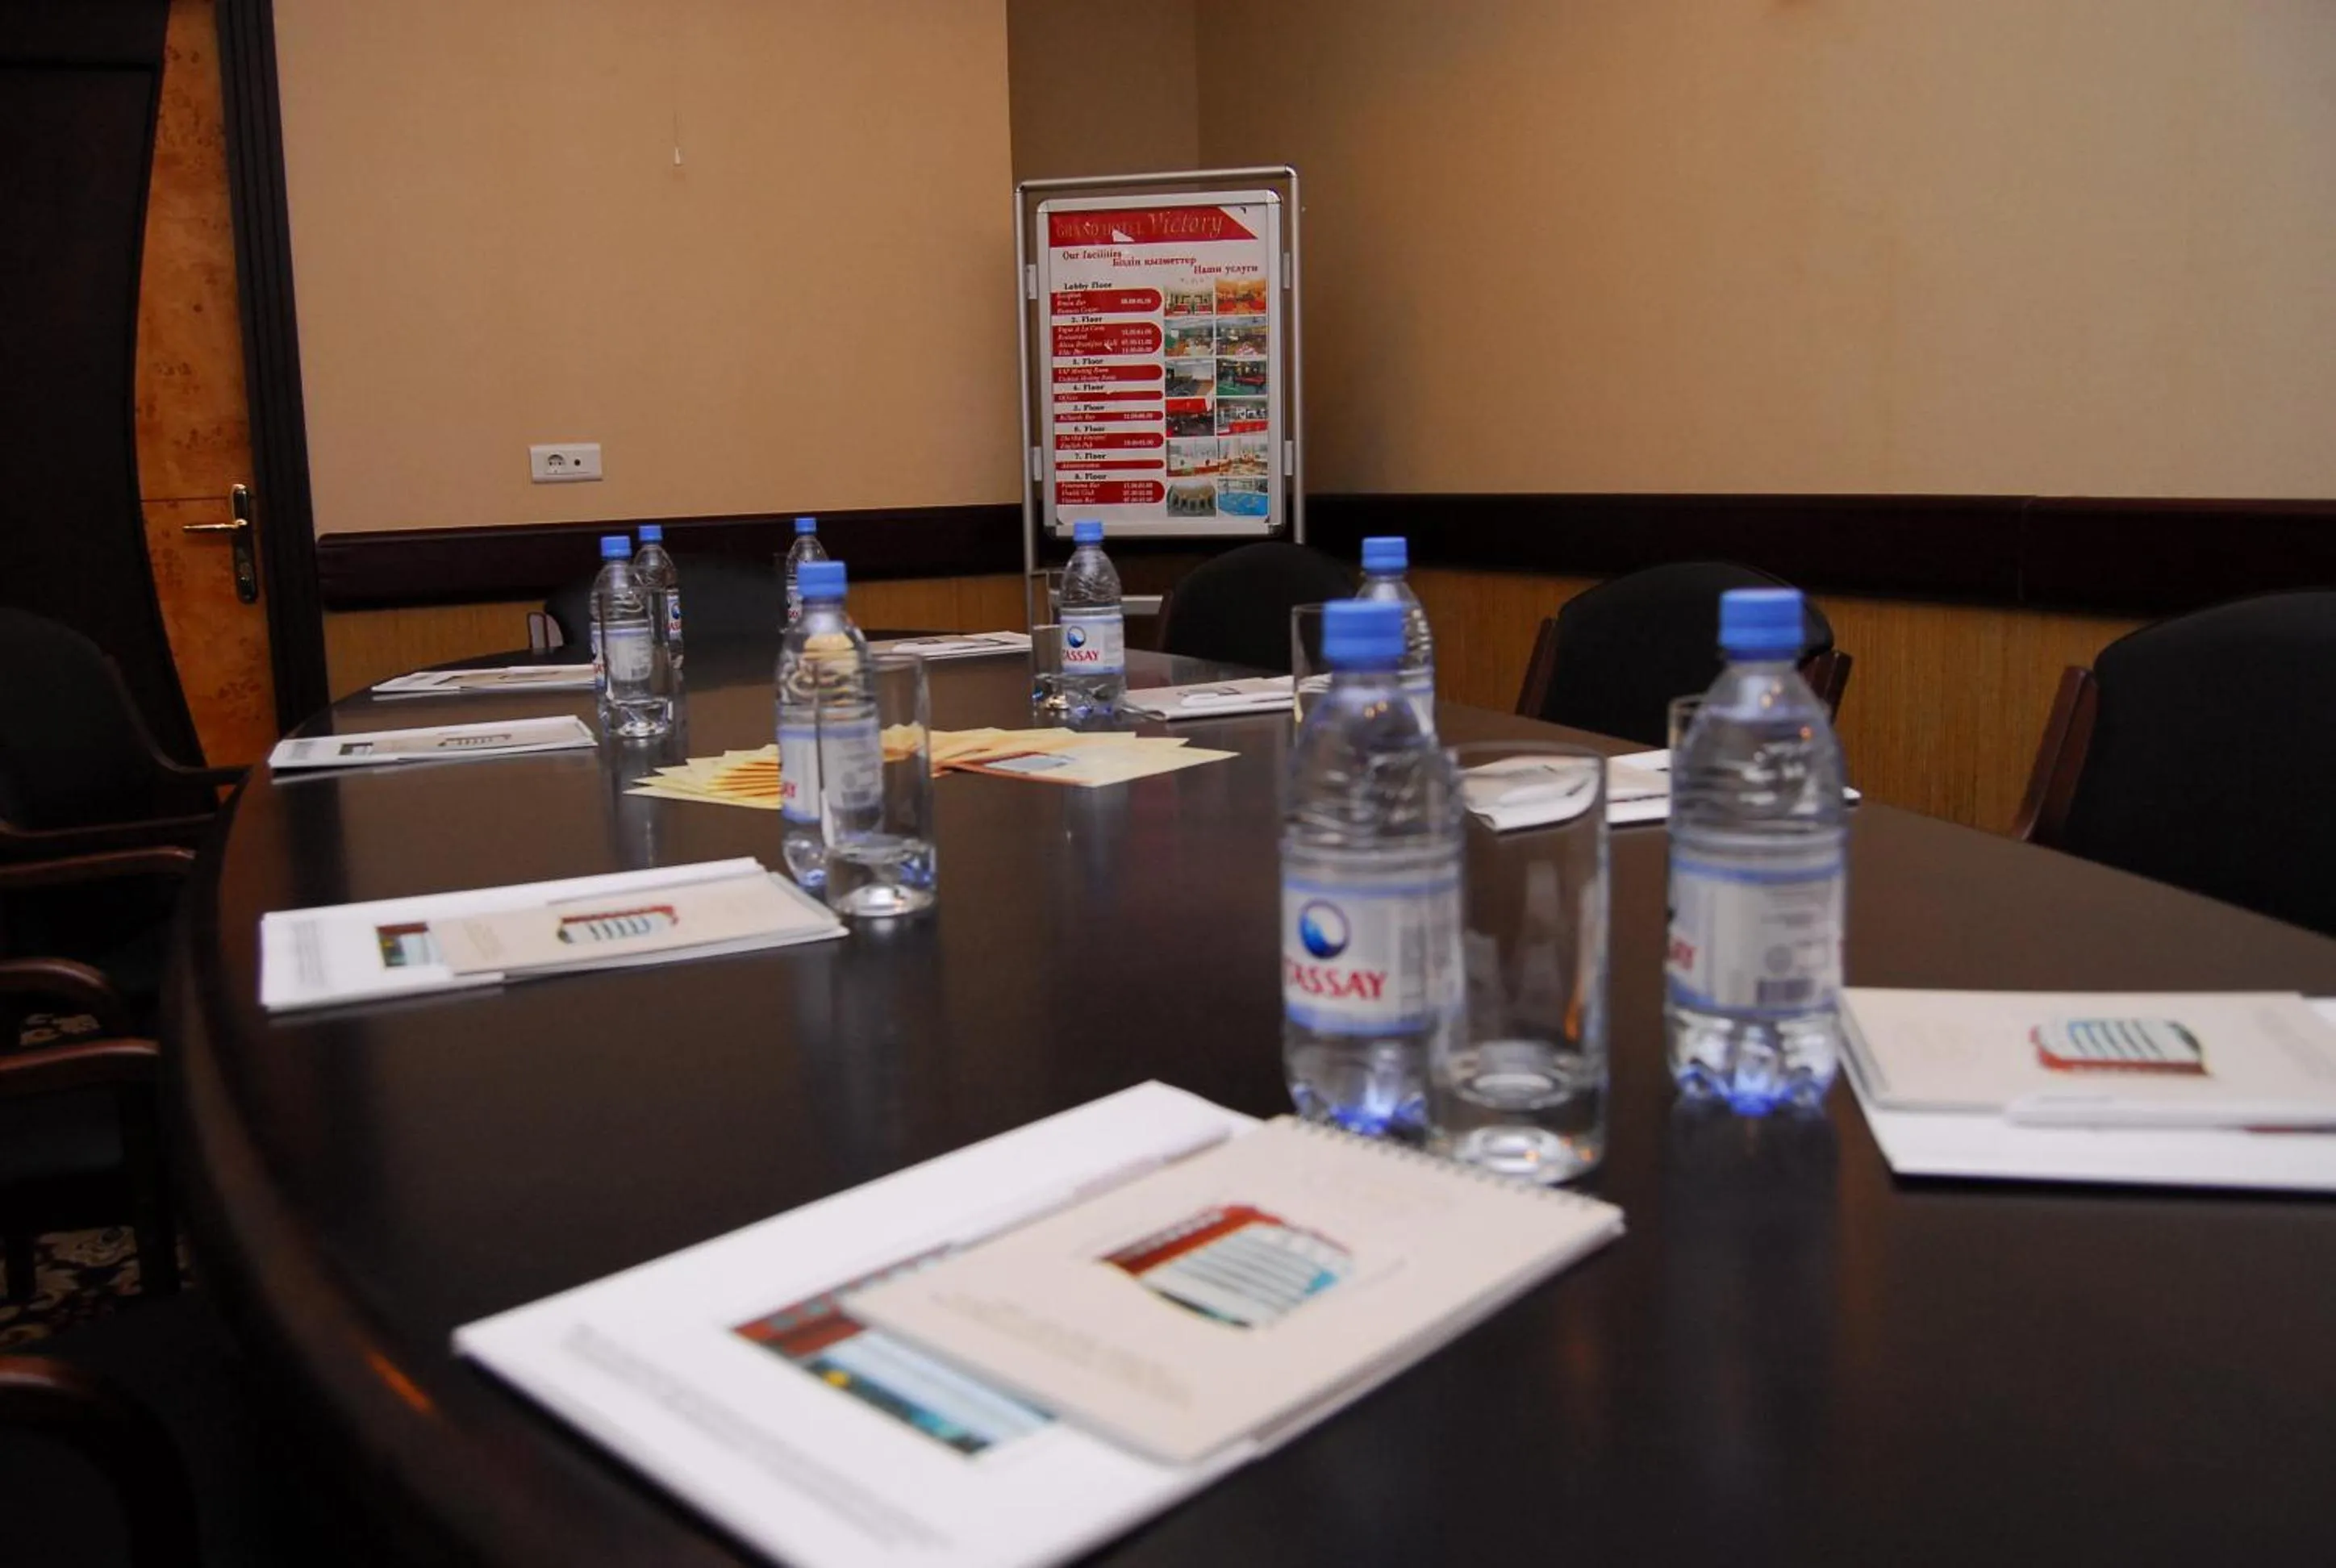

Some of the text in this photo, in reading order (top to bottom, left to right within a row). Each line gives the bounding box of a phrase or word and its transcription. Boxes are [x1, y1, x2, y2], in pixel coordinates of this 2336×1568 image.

[1146, 211, 1224, 240] Victory
[1062, 248, 1122, 261] Our facilities
[1194, 265, 1258, 276] Наши услуги
[1064, 281, 1112, 292] Lobby Floor
